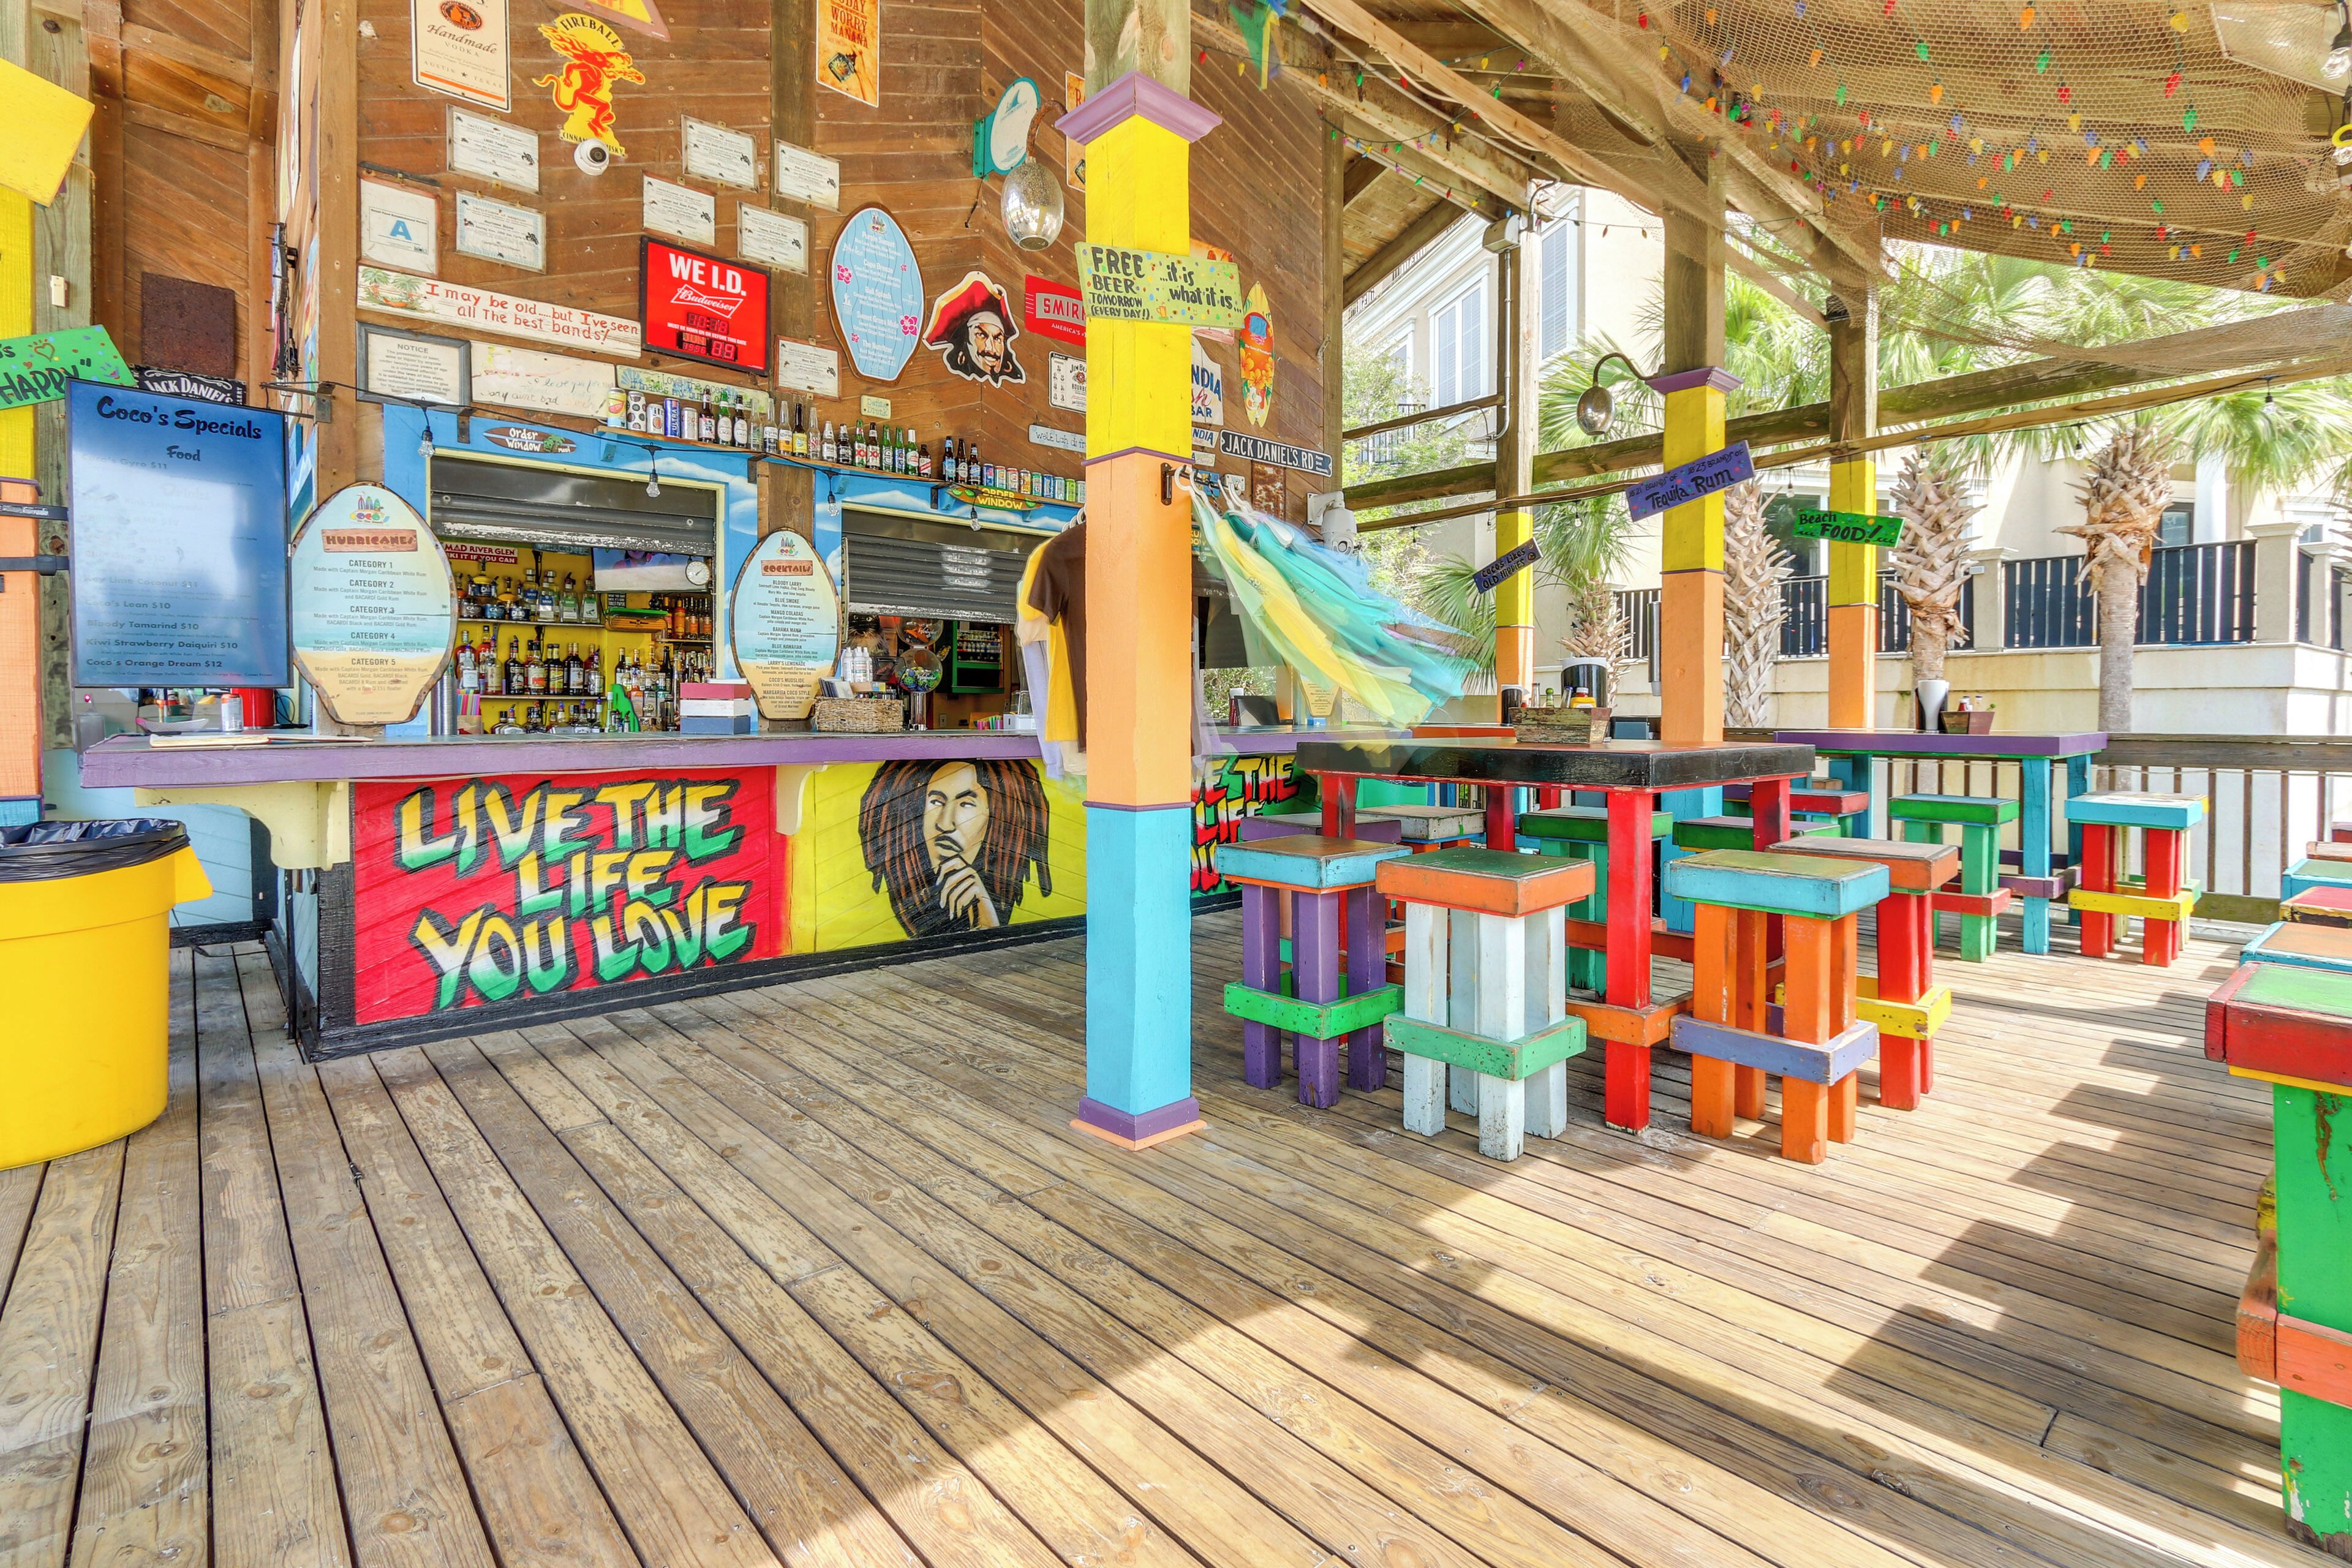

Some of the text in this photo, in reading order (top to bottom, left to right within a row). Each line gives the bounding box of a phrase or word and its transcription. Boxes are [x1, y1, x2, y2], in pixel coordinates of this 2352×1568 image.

[831, 6, 867, 34] WORRY
[427, 24, 497, 54] Handmade
[560, 16, 620, 48] FIREBALL
[445, 42, 480, 58] VODKA
[424, 60, 456, 74] AUSTIN
[473, 76, 503, 89] TEXAS
[390, 220, 412, 241] A
[1091, 246, 1145, 278] FREE
[669, 253, 747, 296] WE I.D.
[1182, 266, 1194, 287] is
[1091, 274, 1137, 295] BEER
[677, 288, 736, 311] Budweiser
[1089, 292, 1142, 307] TOMORROW
[1169, 285, 1204, 306] what
[1205, 287, 1216, 307] it
[426, 283, 439, 296] I
[445, 288, 481, 306] may
[490, 295, 508, 309] be
[581, 312, 607, 329] I've
[610, 321, 638, 334] seen
[1043, 297, 1085, 321] SMIR
[1091, 305, 1150, 320] (EVERY DAY!)
[458, 306, 611, 345] all The best bands!
[686, 326, 699, 334] BORN
[712, 332, 727, 341] BEFORE
[1052, 323, 1080, 336] AMERICA'S
[398, 344, 429, 354] NOTICE
[1070, 364, 1079, 373] JIM
[144, 377, 233, 404] JACK DANIEL'S
[1072, 383, 1087, 393] BOURB
[97, 395, 262, 440] Coco's Specials
[509, 428, 538, 440] Order
[166, 445, 202, 462] Food
[505, 439, 542, 451] Window
[1226, 434, 1254, 458] JACK
[1302, 452, 1314, 470] RD
[120, 458, 146, 469] Gyro
[1645, 448, 1744, 491] BRANDS OF BRANDS OF
[981, 488, 1016, 500] ORDER
[1645, 469, 1735, 510] Tequila Rum
[976, 496, 1023, 510] WINDOW
[1799, 511, 1837, 524] Beach
[326, 536, 414, 545] HURRICANES
[1820, 524, 1883, 543] FOOD!
[445, 545, 516, 556] MAD RIVER GLEN
[349, 559, 386, 568] CATEGORY
[349, 579, 387, 587] CATEGORY
[1483, 575, 1499, 589] OLD
[350, 605, 387, 614] CATEGORY
[87, 619, 126, 629] Bloody
[129, 621, 178, 630] Tamarind
[114, 639, 175, 650] Strawberry
[178, 641, 217, 650] Daiquiri
[86, 659, 122, 668] Coco's
[124, 659, 165, 669] Orange
[1233, 755, 1301, 803] THE
[397, 781, 739, 876] LIVE THE
[518, 850, 676, 918] LIFE
[413, 884, 749, 1009] YOU LOVE
